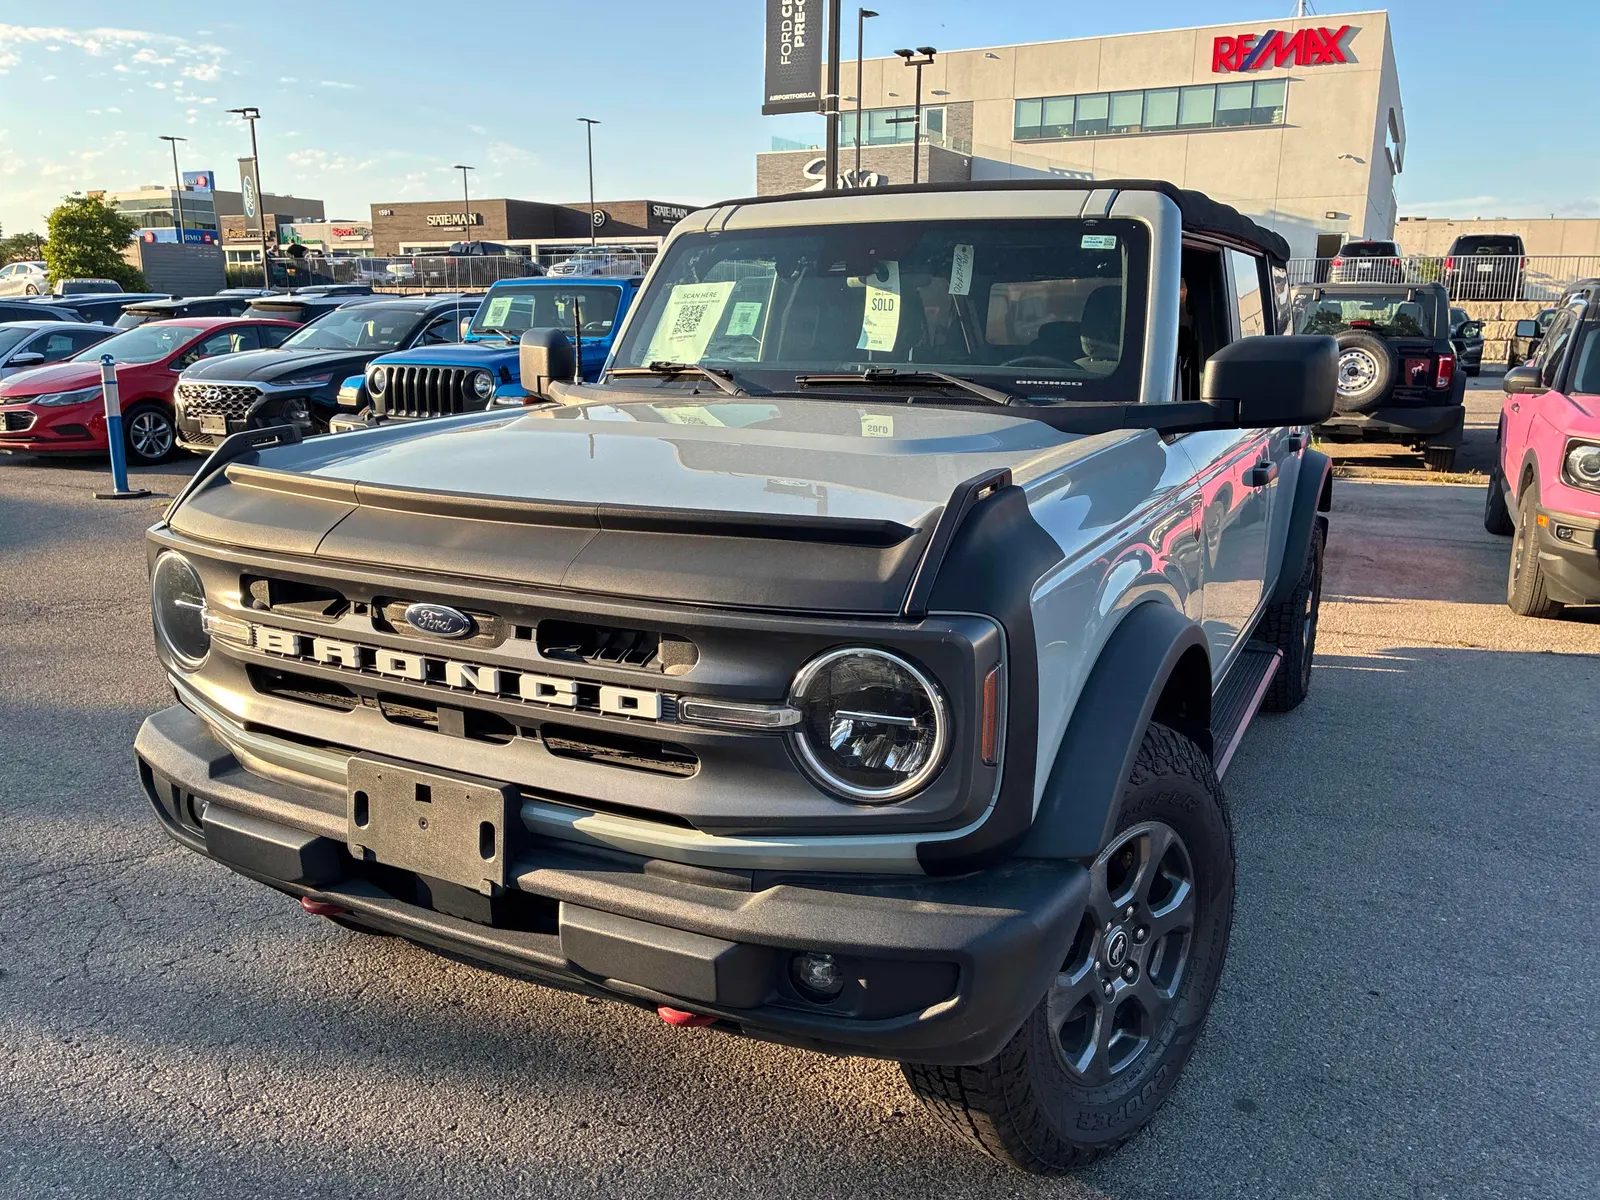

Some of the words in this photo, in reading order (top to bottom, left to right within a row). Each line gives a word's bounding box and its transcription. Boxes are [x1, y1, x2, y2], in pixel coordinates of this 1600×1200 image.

[781, 20, 792, 64] FORD
[1211, 25, 1350, 72] RE/MAX
[769, 91, 816, 101] AIRPORTFORD.CA
[871, 298, 894, 312] SOLD
[257, 624, 663, 721] BRONCO
